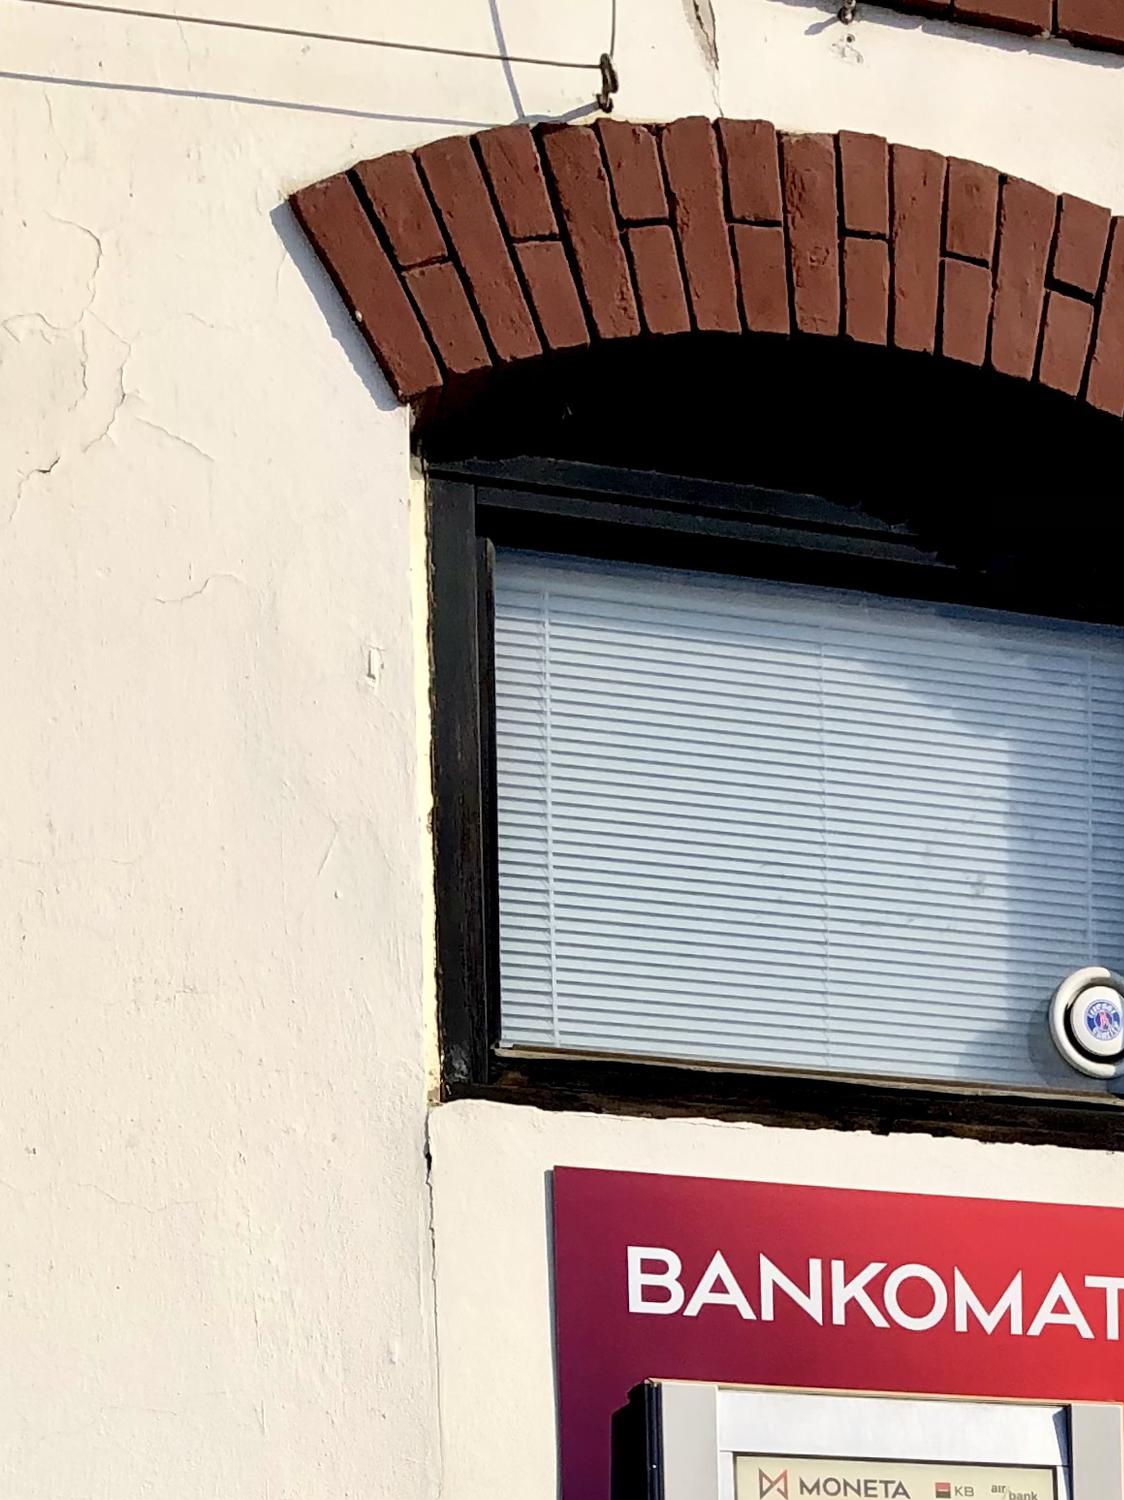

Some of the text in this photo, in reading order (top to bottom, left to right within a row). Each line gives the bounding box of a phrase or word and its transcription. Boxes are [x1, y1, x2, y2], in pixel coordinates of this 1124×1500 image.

[799, 1475, 911, 1500] MONETA
[954, 1485, 975, 1497] KB
[991, 1483, 1006, 1494] air
